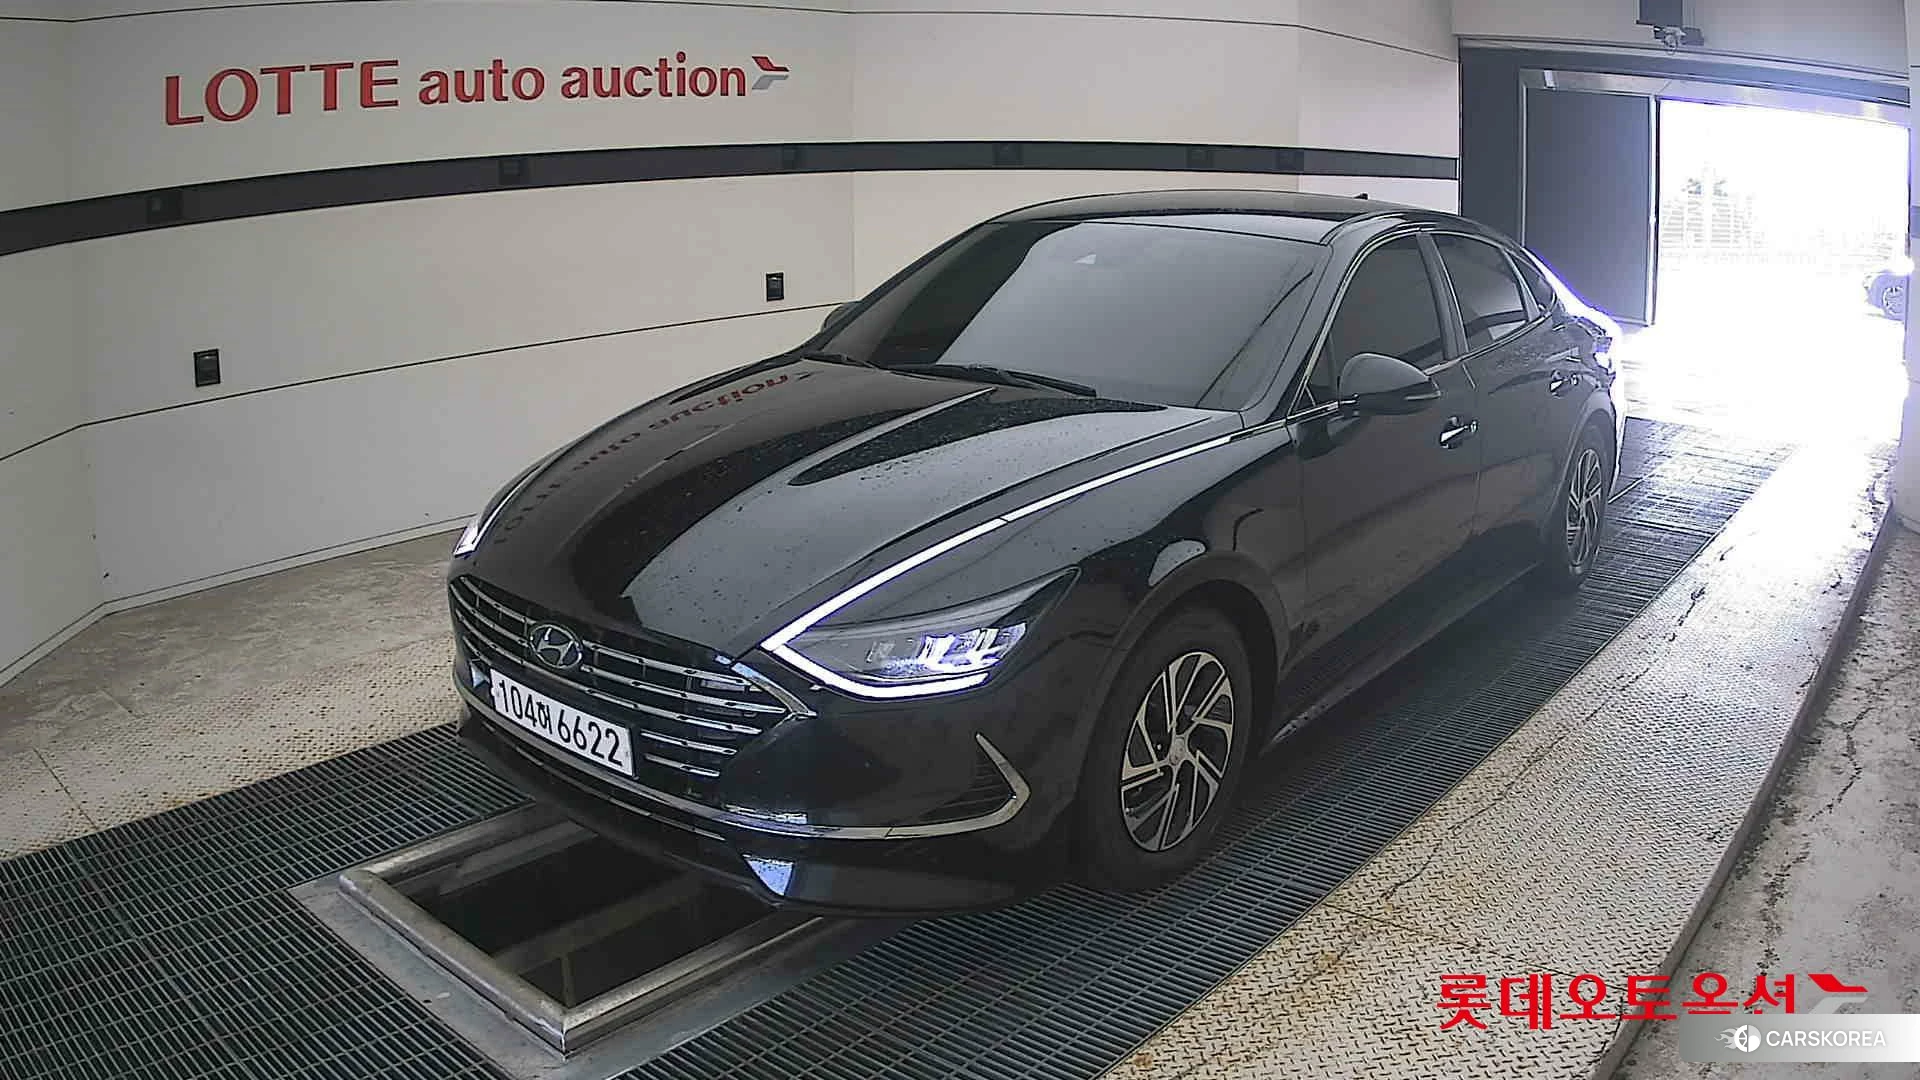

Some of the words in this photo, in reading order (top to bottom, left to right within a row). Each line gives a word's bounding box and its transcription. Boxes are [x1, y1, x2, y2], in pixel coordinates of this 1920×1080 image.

[165, 59, 399, 126] LOTTE
[418, 58, 545, 104] auto
[561, 51, 747, 98] auction
[557, 709, 624, 767] 6622
